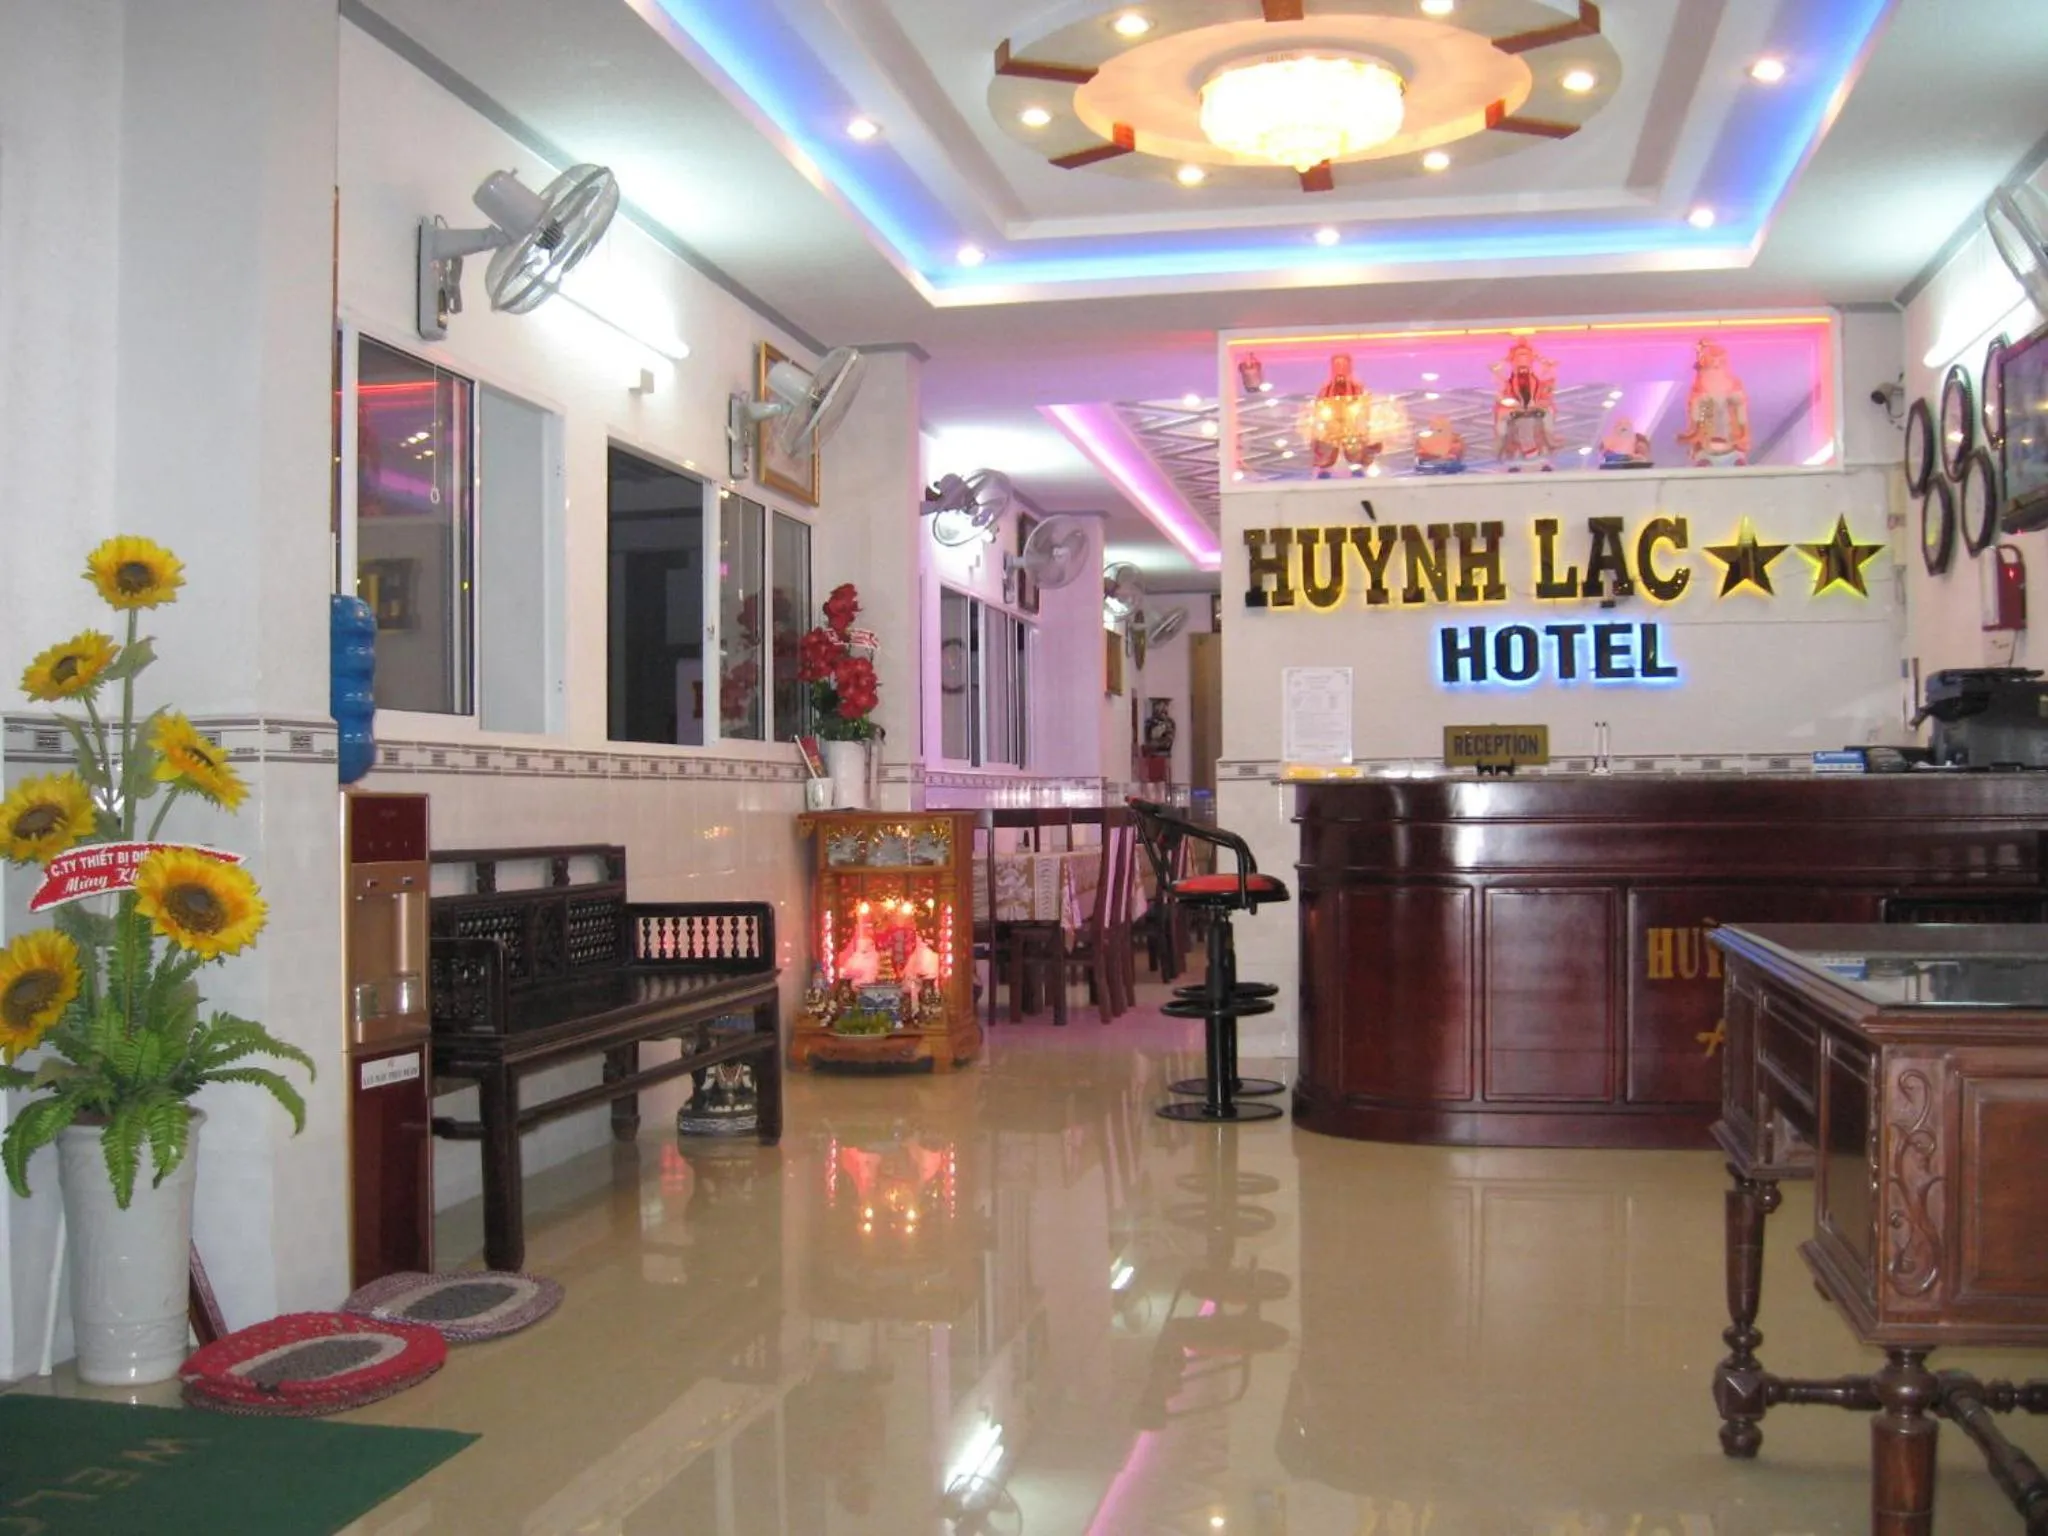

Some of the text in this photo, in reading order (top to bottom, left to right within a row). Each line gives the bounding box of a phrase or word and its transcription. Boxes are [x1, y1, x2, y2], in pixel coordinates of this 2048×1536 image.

[1243, 500, 1507, 609] HUỲNH
[1440, 622, 1678, 684] HOTEL
[1453, 733, 1539, 757] RECEPTION
[50, 859, 77, 877] C.TY
